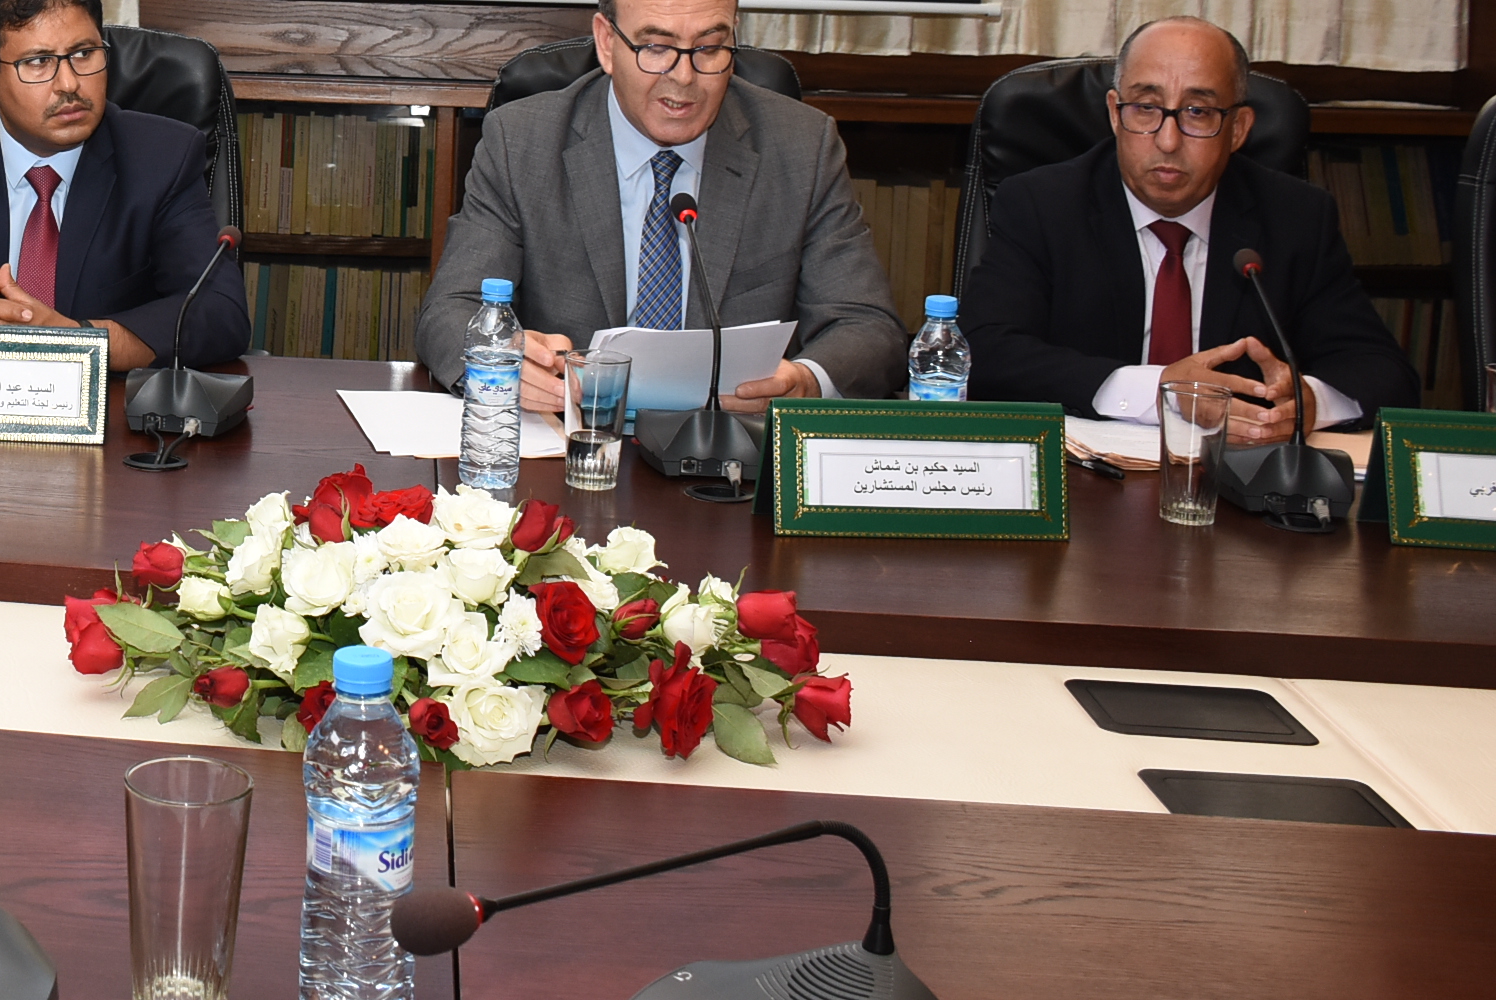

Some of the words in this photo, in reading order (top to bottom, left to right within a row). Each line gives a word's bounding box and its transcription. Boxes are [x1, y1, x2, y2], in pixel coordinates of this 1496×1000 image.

[6, 384, 22, 395] عبد
[27, 383, 55, 395] السيد
[7, 398, 29, 409] التعليم
[31, 397, 49, 409] لجنة
[51, 401, 73, 411] رئيس
[864, 459, 900, 474] شماش
[904, 461, 919, 475] بن
[923, 462, 948, 476] حكيم
[952, 462, 980, 475] السيد
[854, 479, 917, 494] المستشارين
[922, 481, 956, 495] مجلس
[960, 482, 993, 496] رئيس
[377, 847, 409, 874] Sidi
